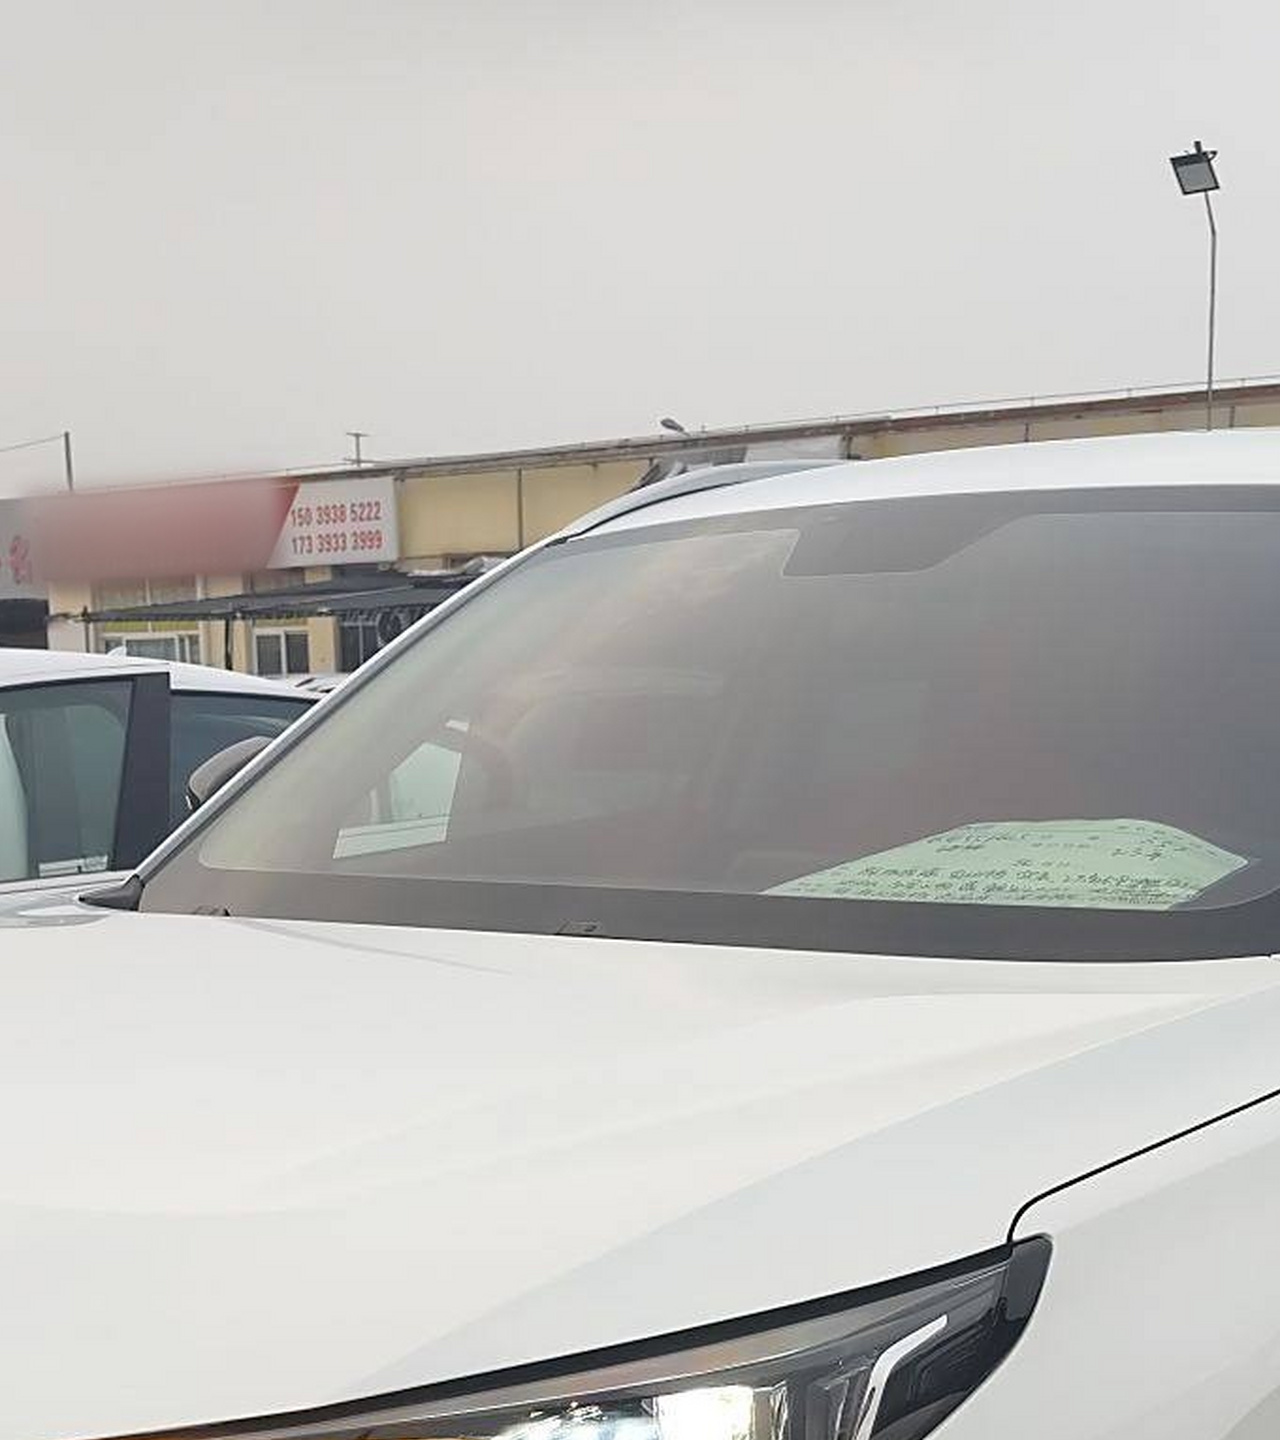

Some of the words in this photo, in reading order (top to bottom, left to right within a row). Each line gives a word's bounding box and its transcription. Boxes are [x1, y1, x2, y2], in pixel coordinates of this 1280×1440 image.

[291, 507, 313, 527] 150
[316, 504, 347, 525] 3938
[349, 501, 382, 523] 5222
[292, 535, 313, 554] 173
[317, 532, 347, 553] 3933
[351, 530, 383, 551] 3999
